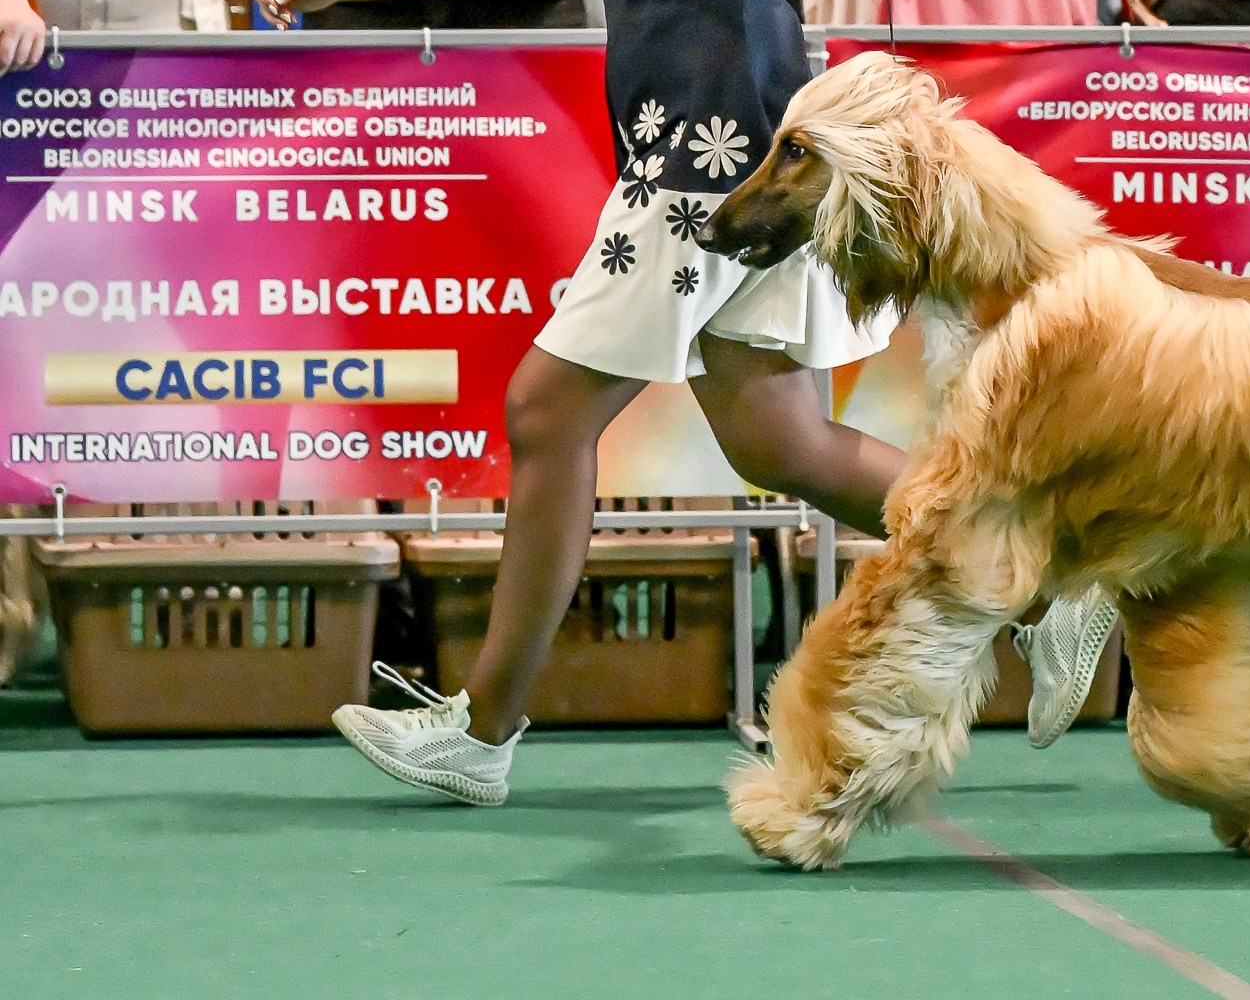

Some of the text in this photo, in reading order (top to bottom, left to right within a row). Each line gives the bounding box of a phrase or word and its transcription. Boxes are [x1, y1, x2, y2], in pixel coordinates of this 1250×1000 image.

[1086, 72, 1159, 91] СОЮЗ
[16, 82, 476, 110] СОЮЗ ОБЩЕСТВЕННЫХ ОБЪЕДИНЕНИЙ
[1018, 101, 1195, 121] «БЕЛОРУССКОЕ
[0, 116, 547, 140] ОРУССКОЕ КИНОЛОГИЧЕСКОЕ ОБЪЕДИНЕНИЕ»
[44, 146, 450, 168] BELORUSSIAN CINOLOGICAL UNION
[46, 187, 450, 222] MINSK BELARUS
[260, 278, 533, 316] ВЫСТАВКА
[115, 358, 386, 400] CACIB FCI
[10, 430, 488, 462] INTERNATIONAL DOG SHOW
